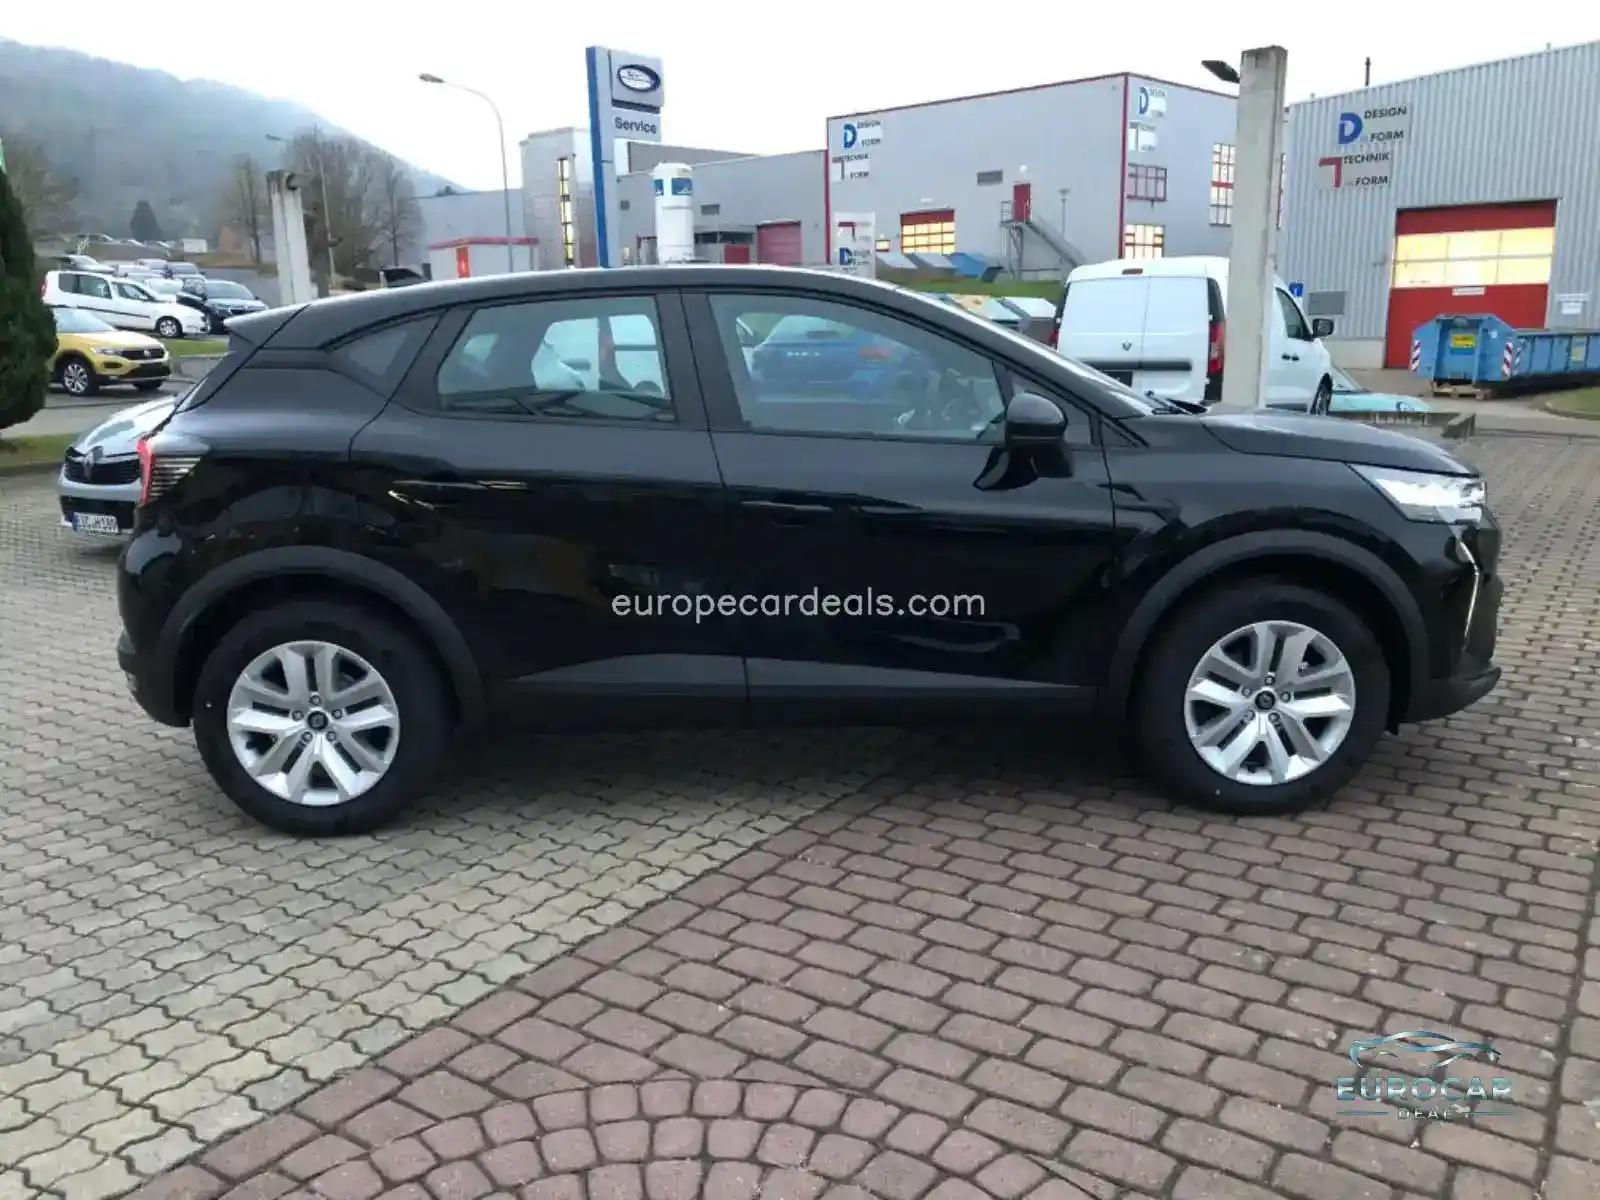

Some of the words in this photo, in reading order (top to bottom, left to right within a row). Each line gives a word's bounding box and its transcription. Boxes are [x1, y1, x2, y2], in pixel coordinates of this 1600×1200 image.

[1363, 106, 1407, 120] DESIGN
[614, 116, 657, 135] Service
[1338, 112, 1363, 145] D
[1370, 130, 1404, 142] FORM
[1344, 152, 1390, 164] TECHNIK
[1355, 175, 1388, 187] FORM
